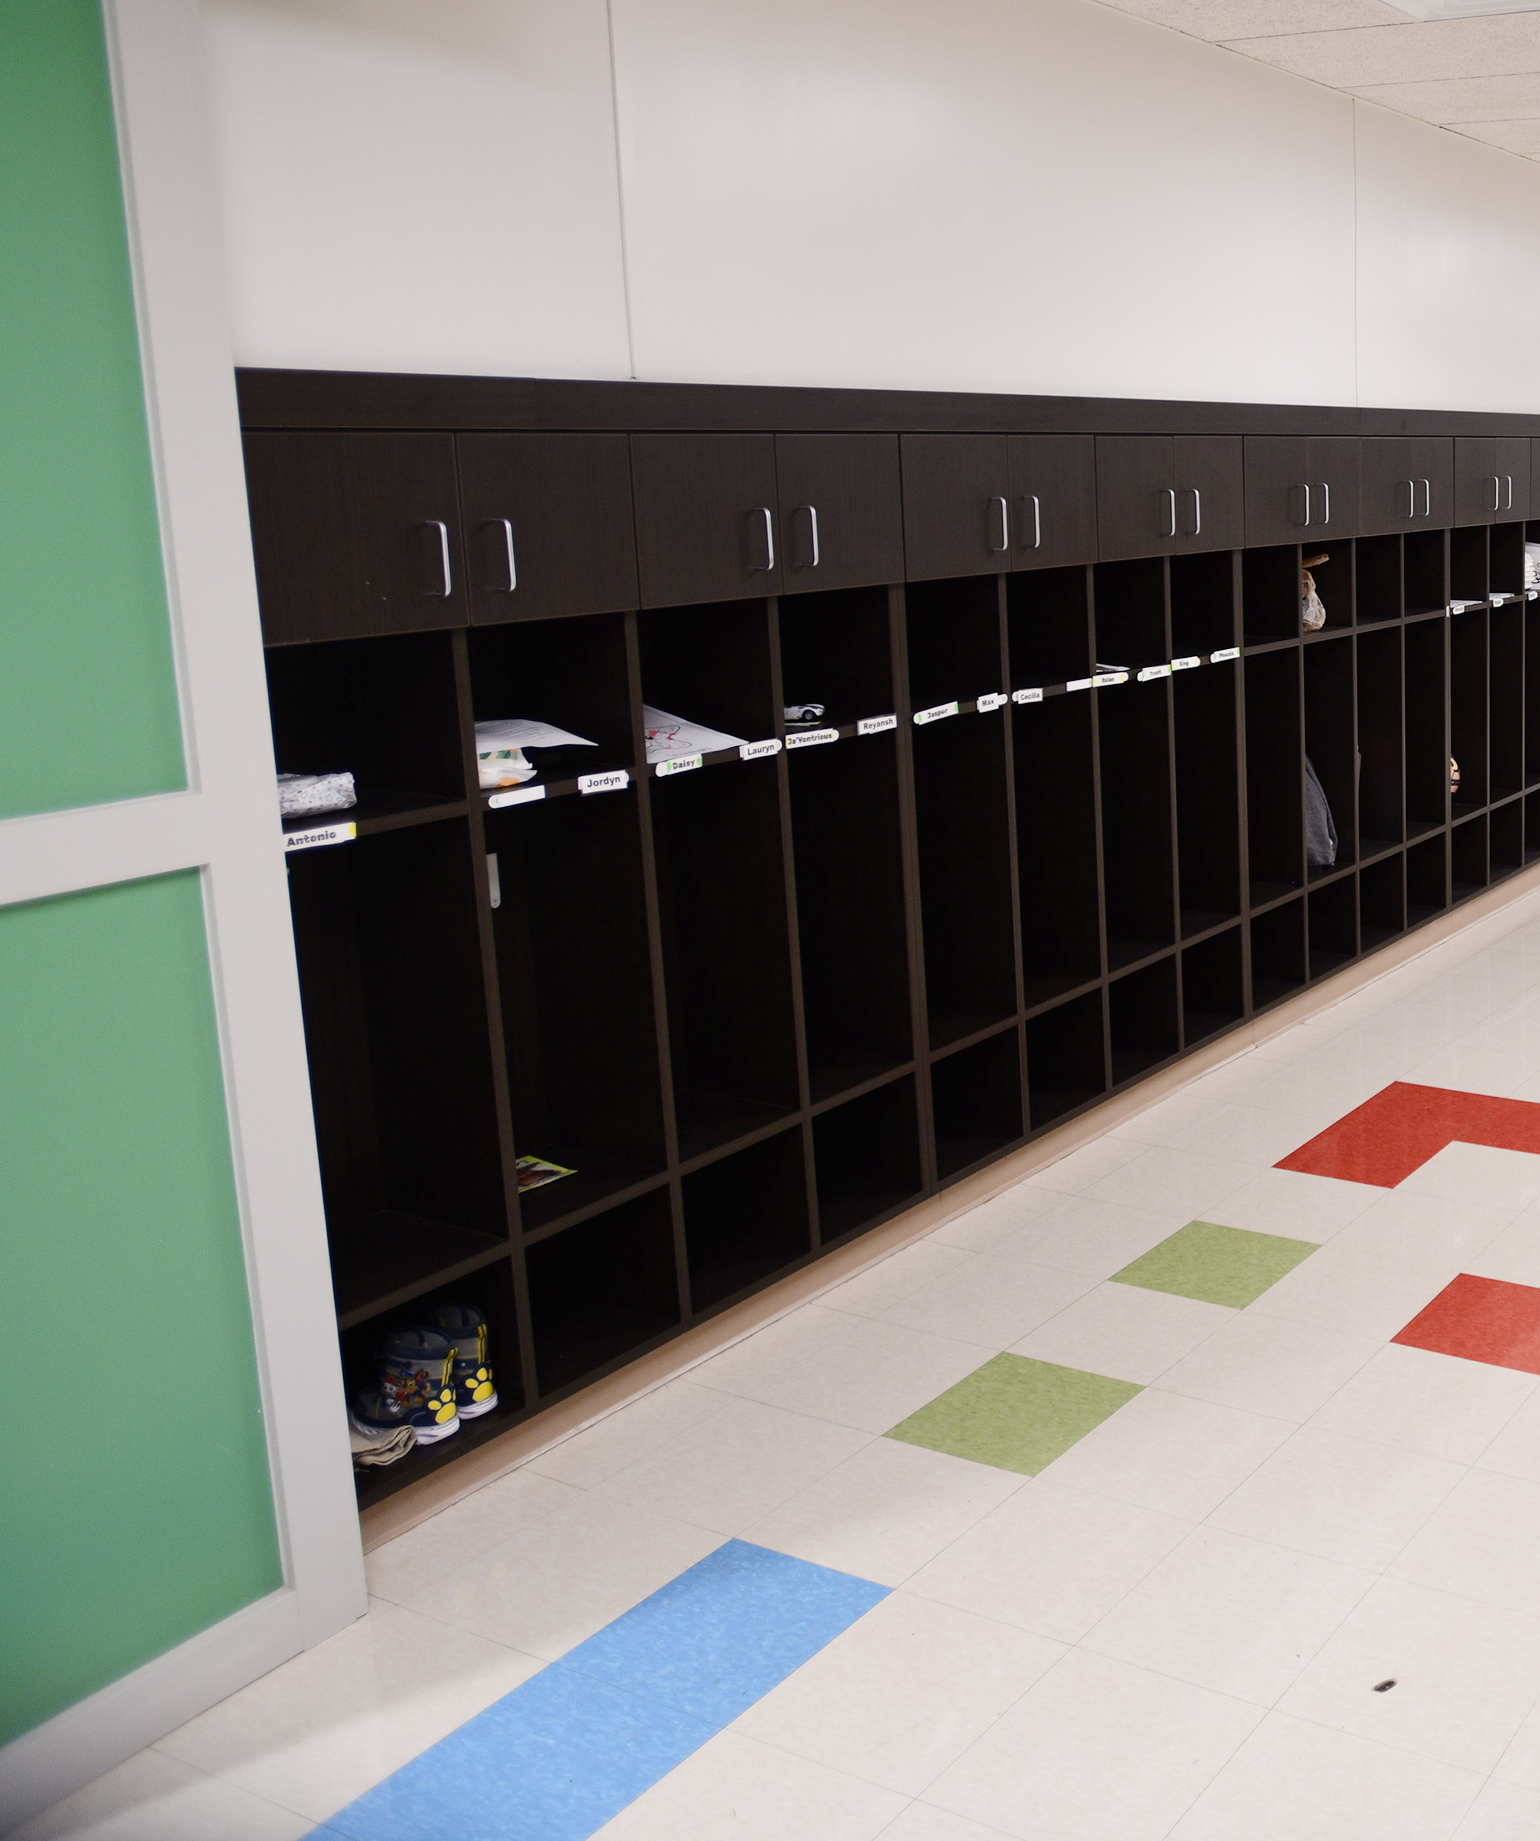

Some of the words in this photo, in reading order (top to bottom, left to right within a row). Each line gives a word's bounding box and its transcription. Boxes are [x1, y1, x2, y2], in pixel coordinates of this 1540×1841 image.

[1020, 691, 1040, 700] Cecilia
[927, 708, 948, 719] Jasper
[863, 718, 894, 730] Reyansh
[747, 743, 775, 755] Lauryn
[672, 759, 696, 770] Daisy
[587, 775, 621, 788] Jordyn
[287, 830, 337, 847] Antonio
